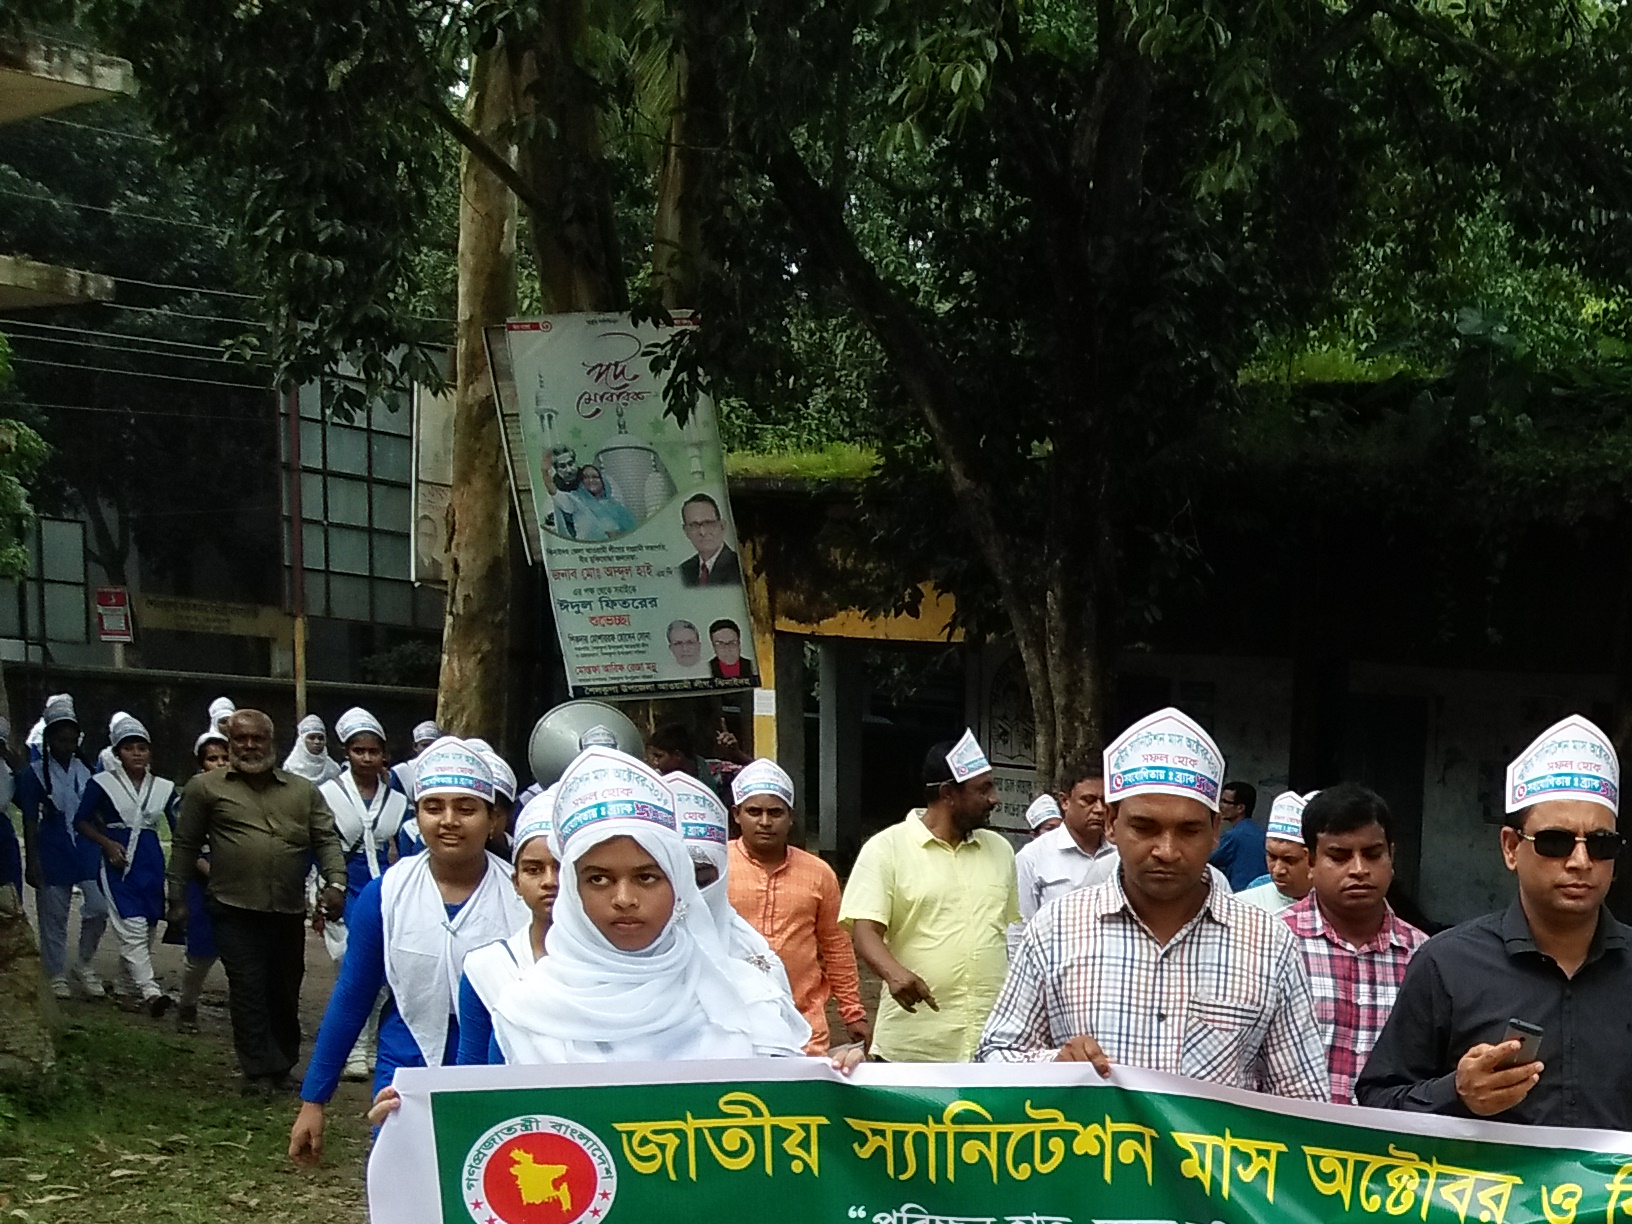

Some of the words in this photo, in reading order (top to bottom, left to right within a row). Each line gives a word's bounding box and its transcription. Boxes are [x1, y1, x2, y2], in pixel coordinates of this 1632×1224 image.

[549, 1120, 615, 1181] বাংলাদেশ
[612, 1092, 831, 1182] জাতীয়
[845, 1100, 1160, 1186] স্যানিটেশন
[1171, 1127, 1287, 1204] মাস
